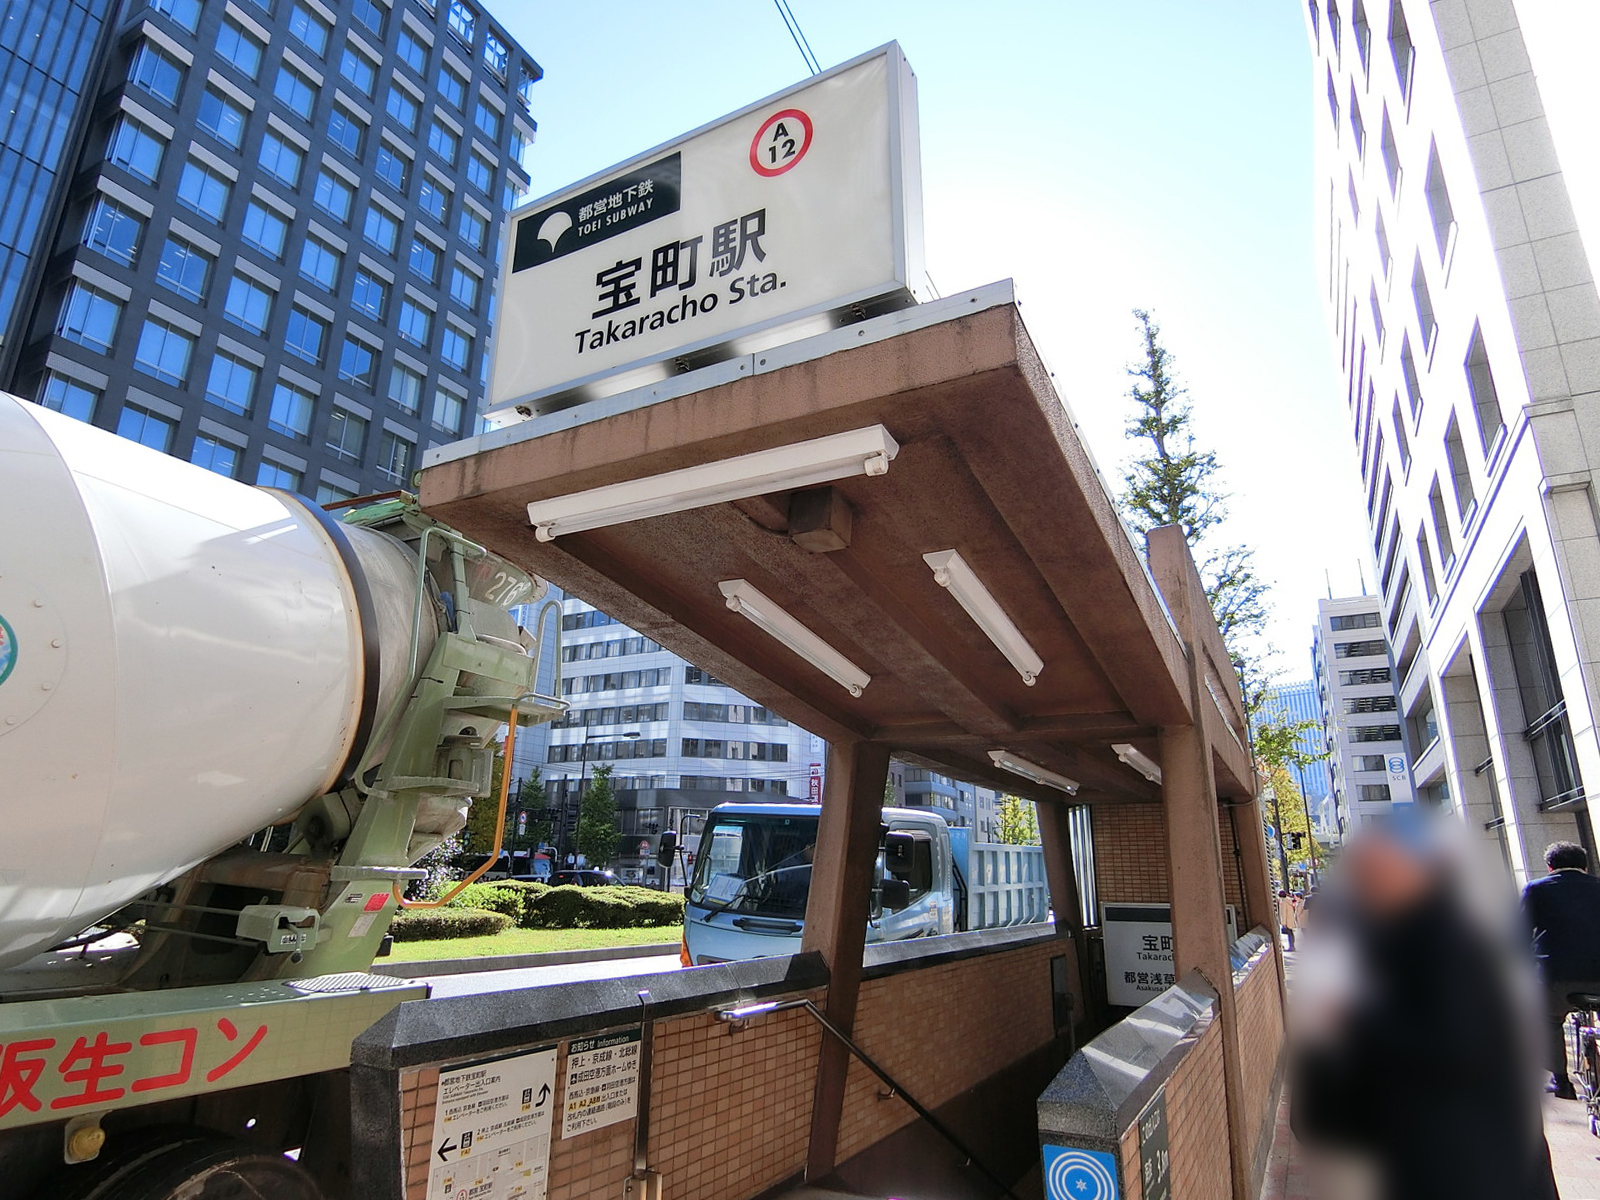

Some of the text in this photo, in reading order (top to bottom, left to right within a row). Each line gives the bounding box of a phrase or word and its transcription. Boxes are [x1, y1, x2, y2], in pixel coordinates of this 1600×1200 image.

[773, 122, 789, 142] A
[769, 141, 796, 164] 12
[578, 178, 654, 222] 都営地下鉄
[578, 198, 654, 237] TOEI SUBWAY
[591, 208, 767, 320] 宝町駅
[575, 271, 787, 355] Takaracho Sta.
[1124, 971, 1176, 986] 都営浅草
[1136, 984, 1164, 992] Asakusa
[571, 1034, 630, 1053] お知らせ Information
